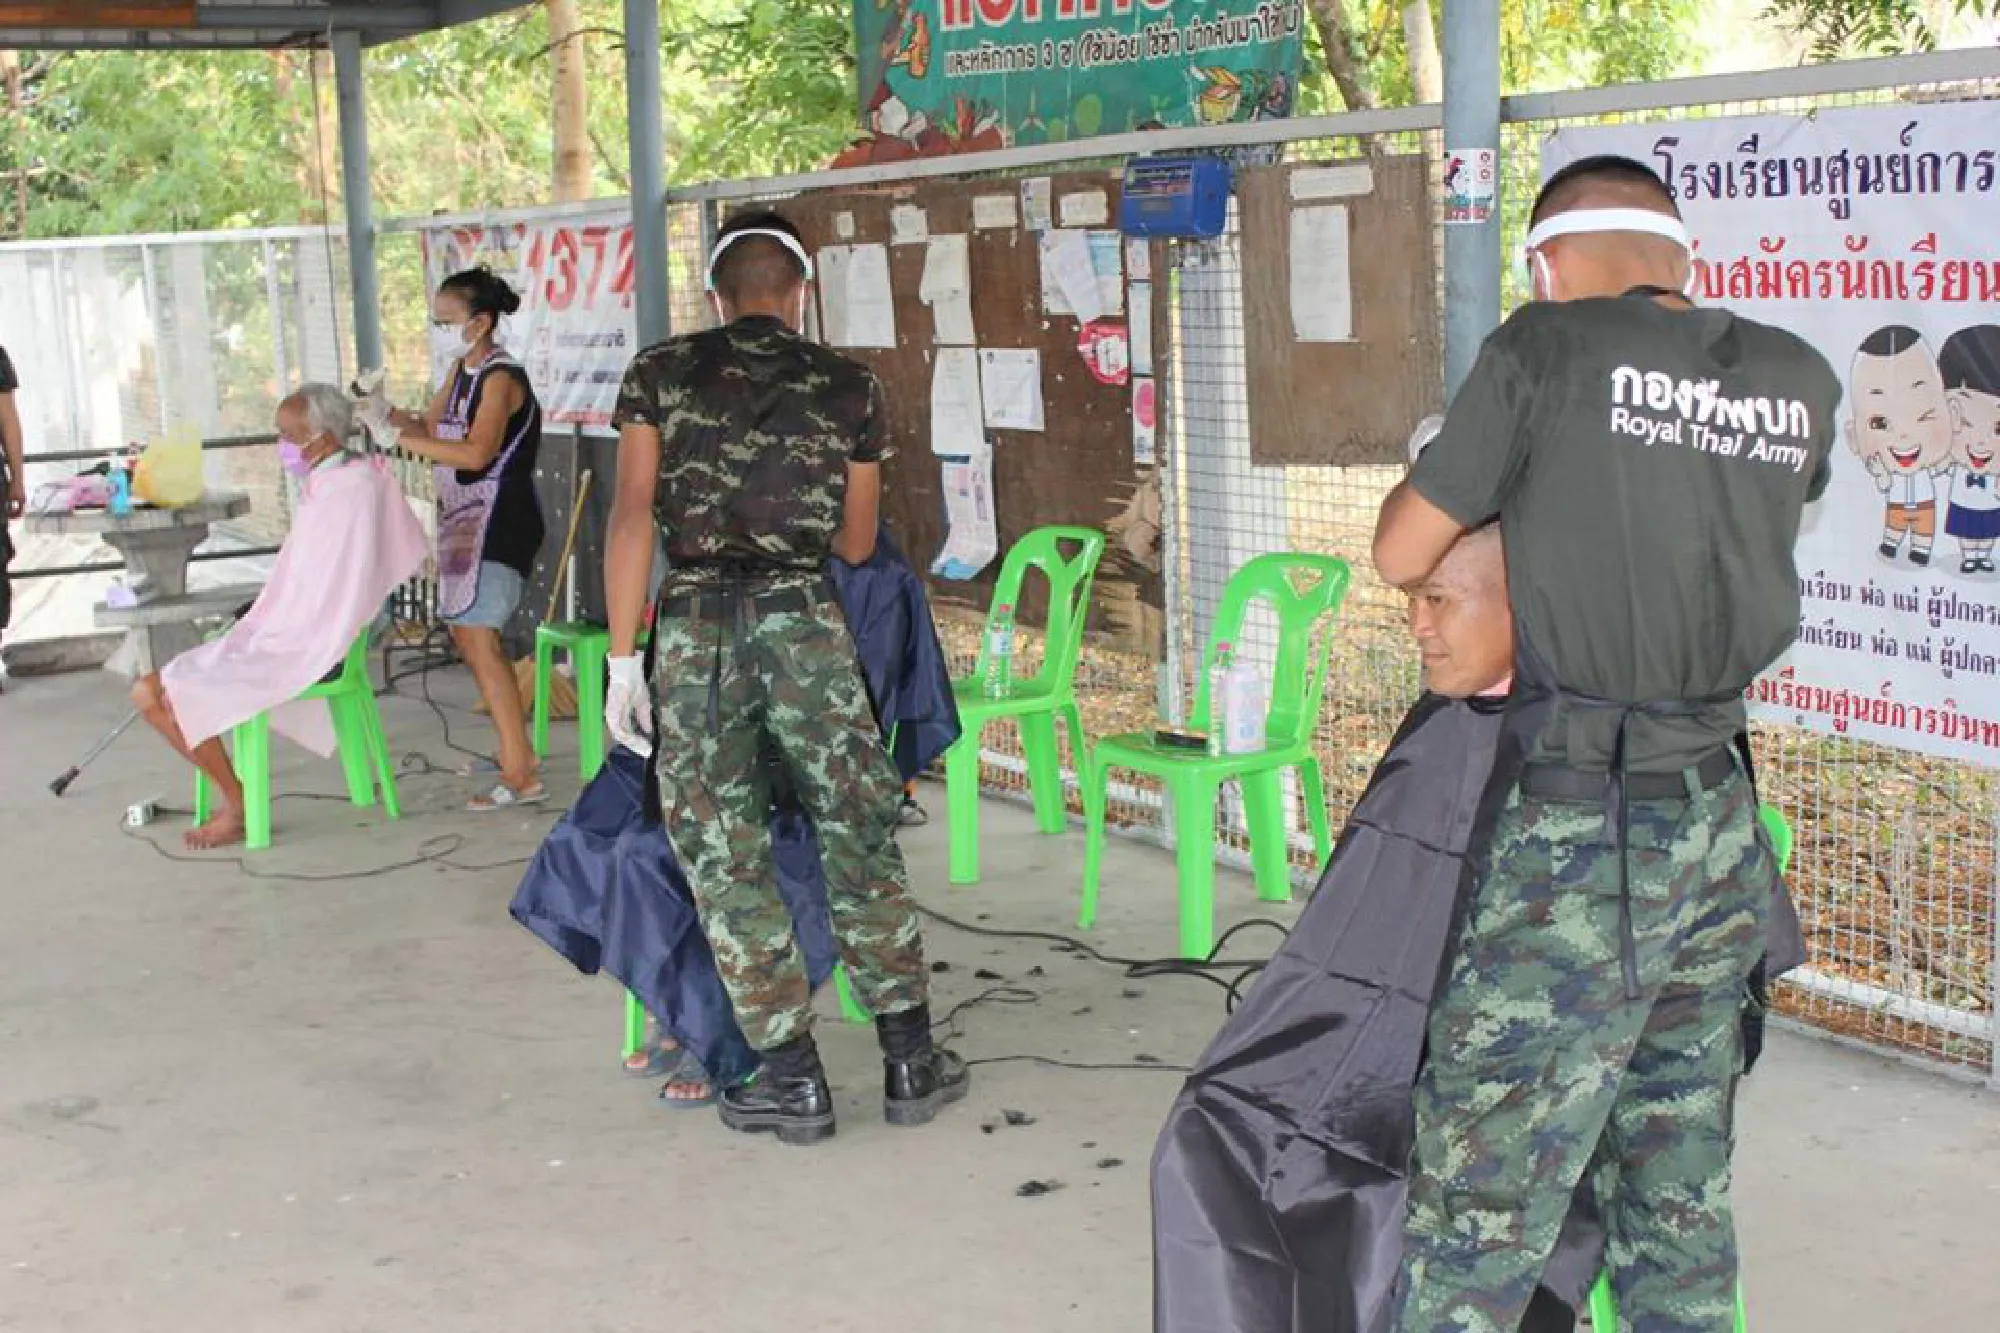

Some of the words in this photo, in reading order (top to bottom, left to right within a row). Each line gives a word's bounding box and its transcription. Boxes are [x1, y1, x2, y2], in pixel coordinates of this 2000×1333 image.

[944, 39, 1037, 77] และหลักการ
[1611, 366, 1811, 440] กองทัพบก
[1611, 406, 1682, 446] Royal
[1689, 424, 1744, 456] Thai
[1748, 436, 1808, 473] Army
[1860, 577, 1886, 607] พ่อ
[1893, 586, 1920, 613] แม่
[1872, 628, 1898, 657] พ่อ
[1905, 636, 1932, 662] แม่
